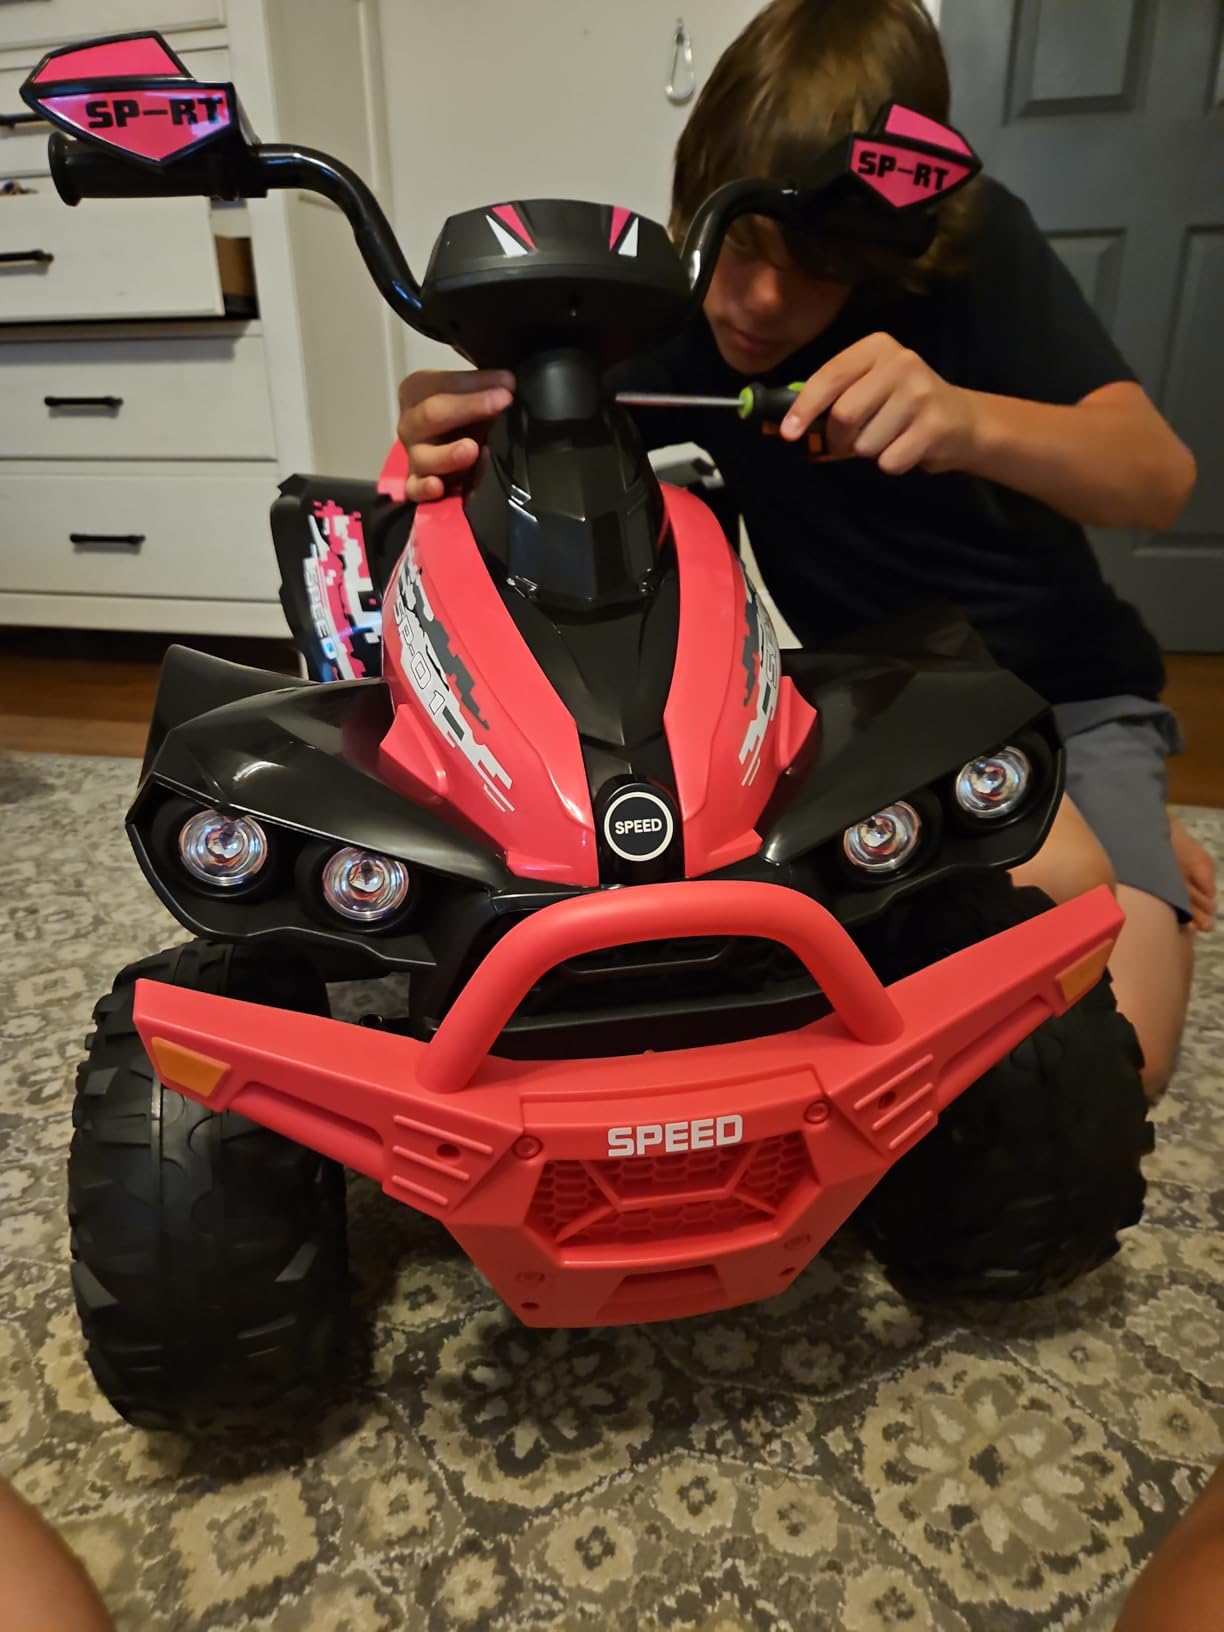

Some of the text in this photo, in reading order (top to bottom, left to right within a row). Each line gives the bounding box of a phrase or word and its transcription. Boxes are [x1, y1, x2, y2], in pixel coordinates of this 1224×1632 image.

[85, 97, 223, 129] SP-RT
[858, 151, 948, 191] SP-RT
[614, 818, 662, 835] SPEED
[608, 1114, 743, 1157] SPEED
